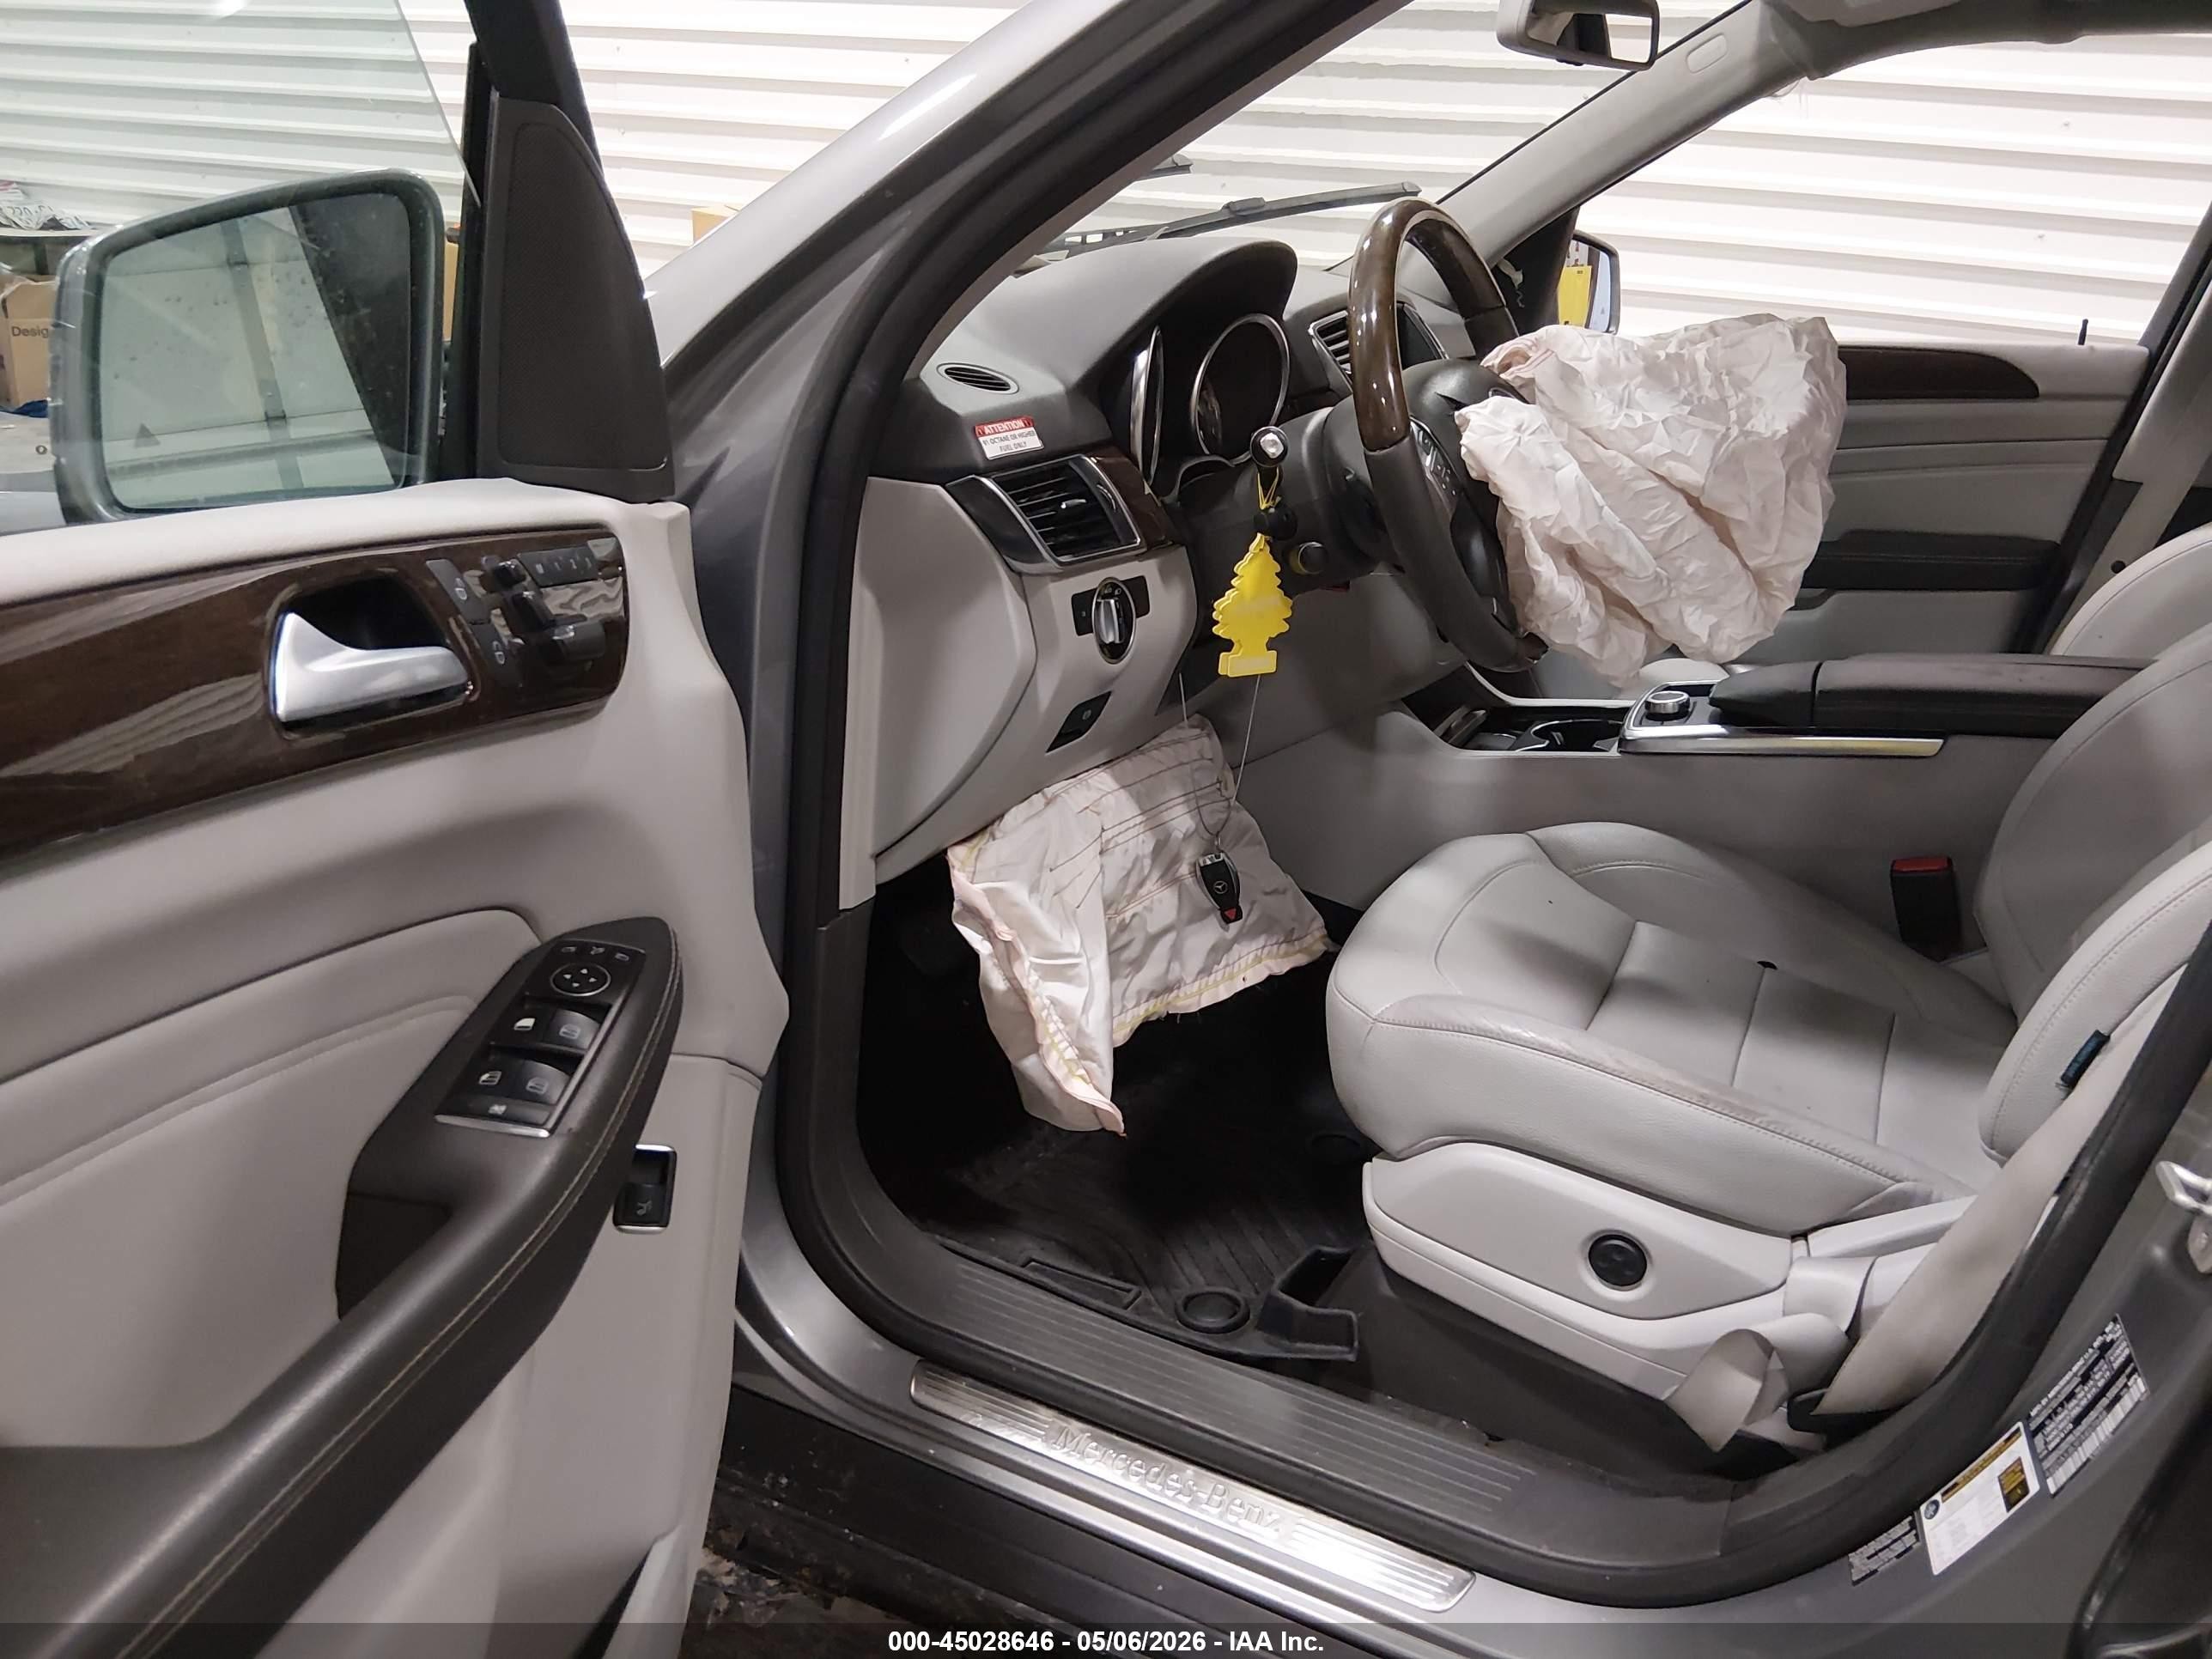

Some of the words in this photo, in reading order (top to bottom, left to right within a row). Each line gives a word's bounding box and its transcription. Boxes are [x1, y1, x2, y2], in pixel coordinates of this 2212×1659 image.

[984, 419, 1025, 434] ATTENTION
[990, 434, 1010, 444] OCTANE
[1051, 1425, 1280, 1533] Mercedes-Benz
